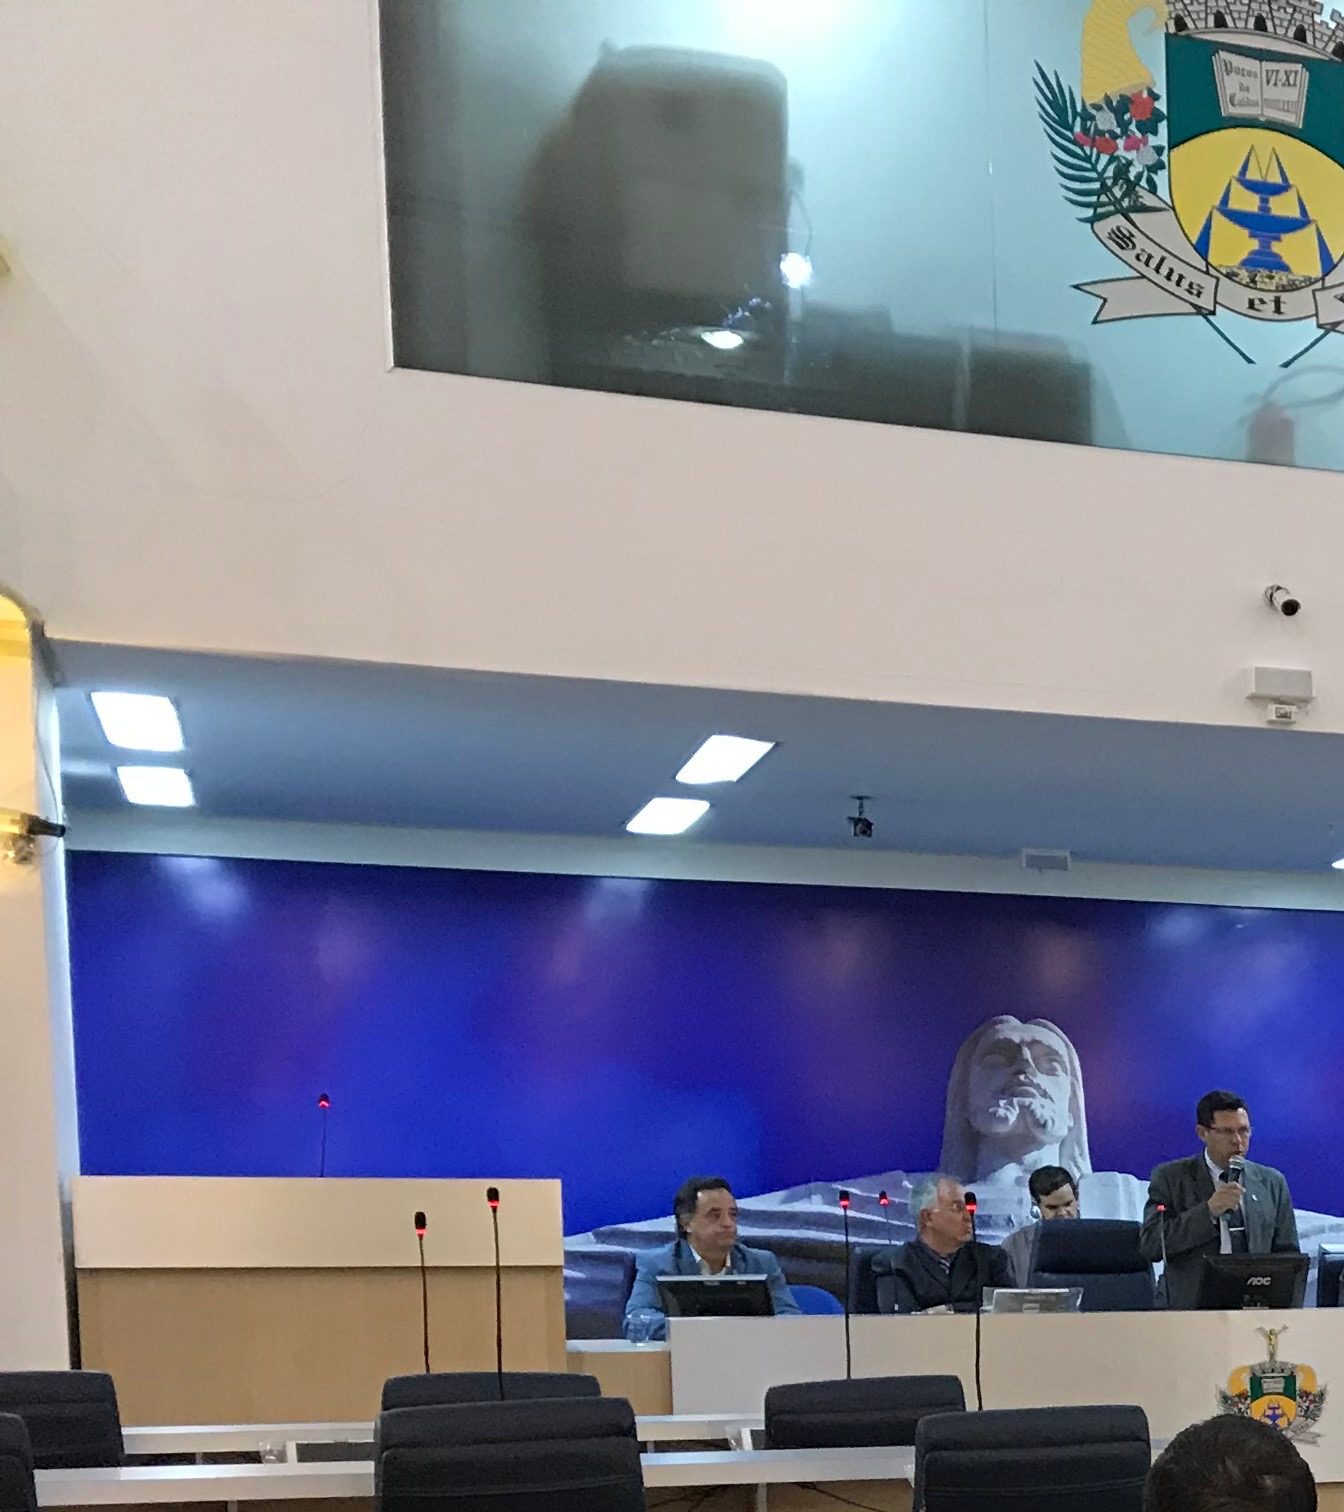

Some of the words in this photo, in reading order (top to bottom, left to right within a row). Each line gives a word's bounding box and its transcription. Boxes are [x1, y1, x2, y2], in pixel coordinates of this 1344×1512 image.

[1105, 224, 1205, 299] Salus
[1246, 294, 1289, 315] et
[1246, 1276, 1271, 1286] AOC
